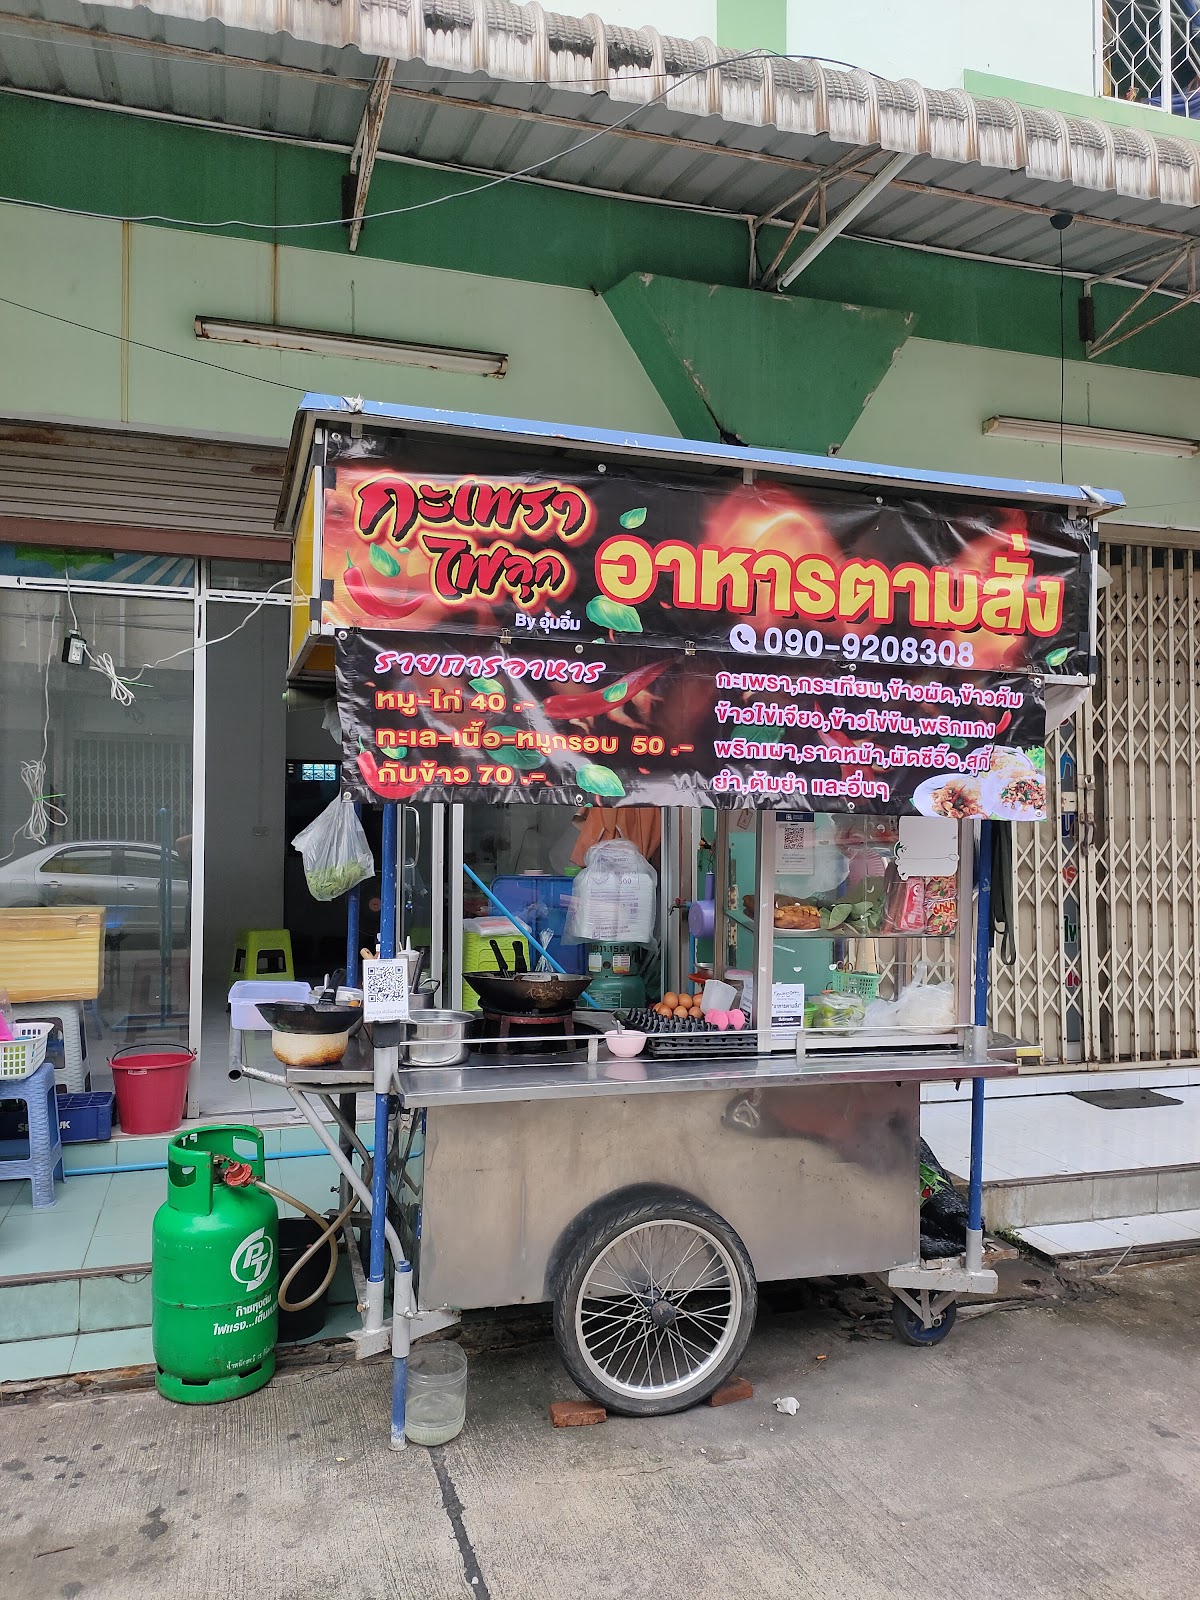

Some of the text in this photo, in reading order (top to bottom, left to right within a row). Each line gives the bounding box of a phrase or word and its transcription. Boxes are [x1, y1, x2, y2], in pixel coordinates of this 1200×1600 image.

[354, 474, 590, 544] กะเพรา
[418, 532, 569, 607] ไฟลุก
[595, 530, 1064, 637] อาหารตามสั่ง
[515, 613, 536, 630] By
[763, 627, 975, 667] 090-9208308
[374, 651, 606, 683] รายการอาหาร
[375, 688, 462, 716] หมู-ไก่
[470, 692, 506, 712] 40
[632, 736, 665, 755] 50
[377, 760, 470, 785] กับข้าว
[478, 764, 513, 785] 70
[811, 770, 889, 801] และอื่นๆ
